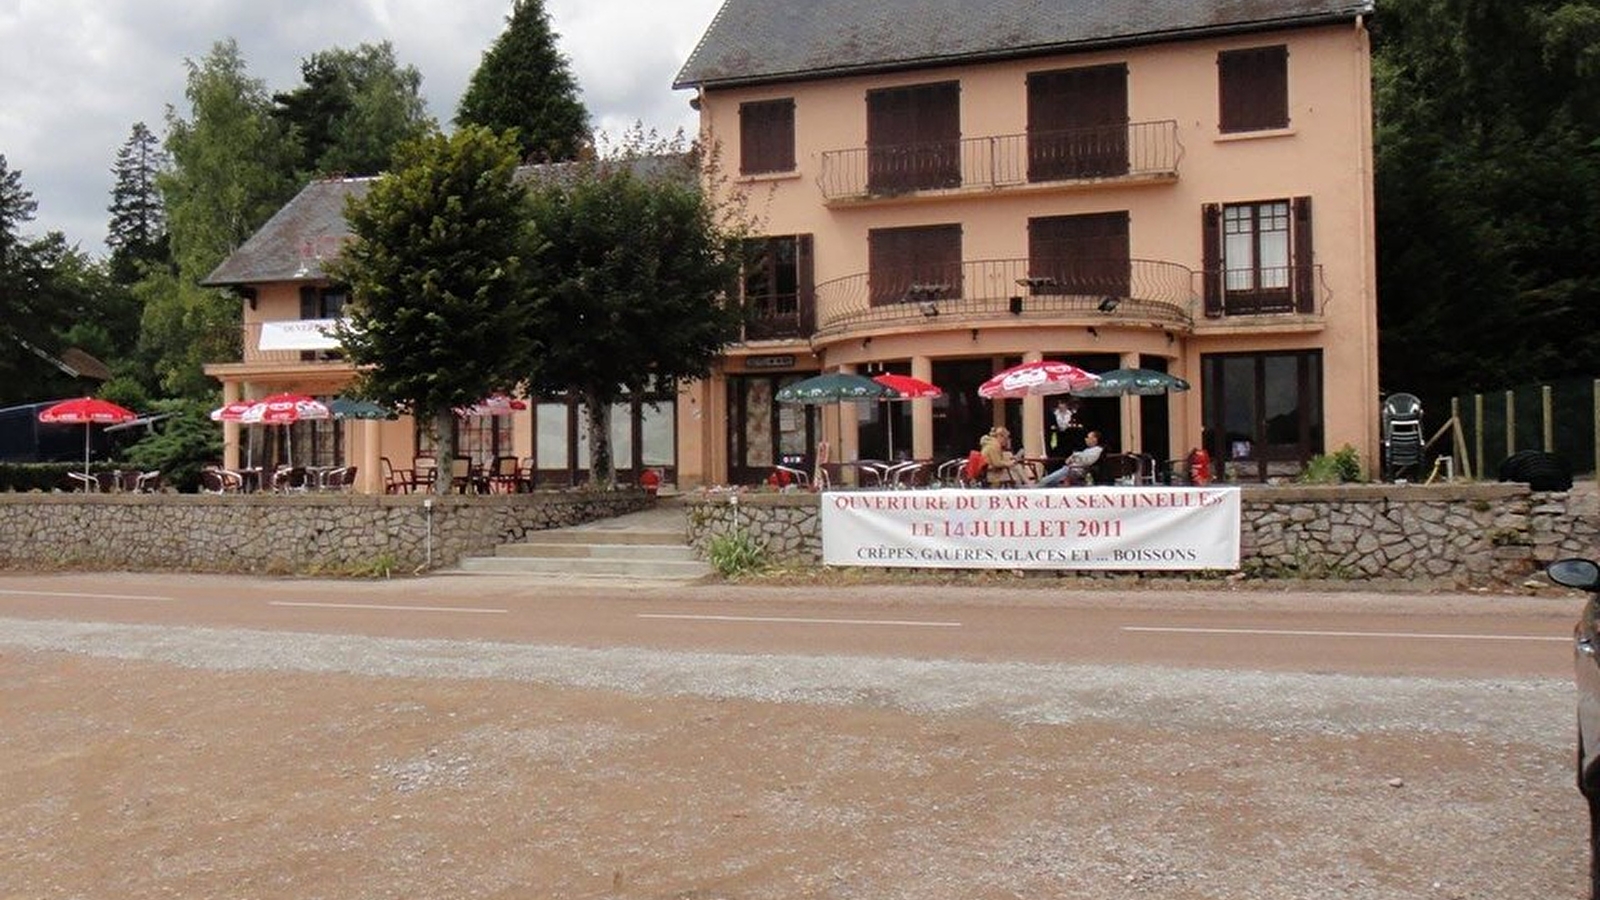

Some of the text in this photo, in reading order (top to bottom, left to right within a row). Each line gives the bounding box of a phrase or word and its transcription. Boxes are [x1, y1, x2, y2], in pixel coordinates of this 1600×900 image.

[835, 495, 949, 510] OUVERTURE
[956, 495, 981, 510] DU
[988, 495, 1029, 510] BAR
[1034, 494, 1071, 509] «LA
[911, 520, 1122, 538] LE 14 JUILLET 2011
[857, 544, 918, 561] CRÊPES,
[921, 547, 997, 561] GAUFRES,
[1001, 548, 1066, 561] GLACES
[1071, 549, 1092, 561] ET
[1113, 549, 1197, 561] BOISSONS
